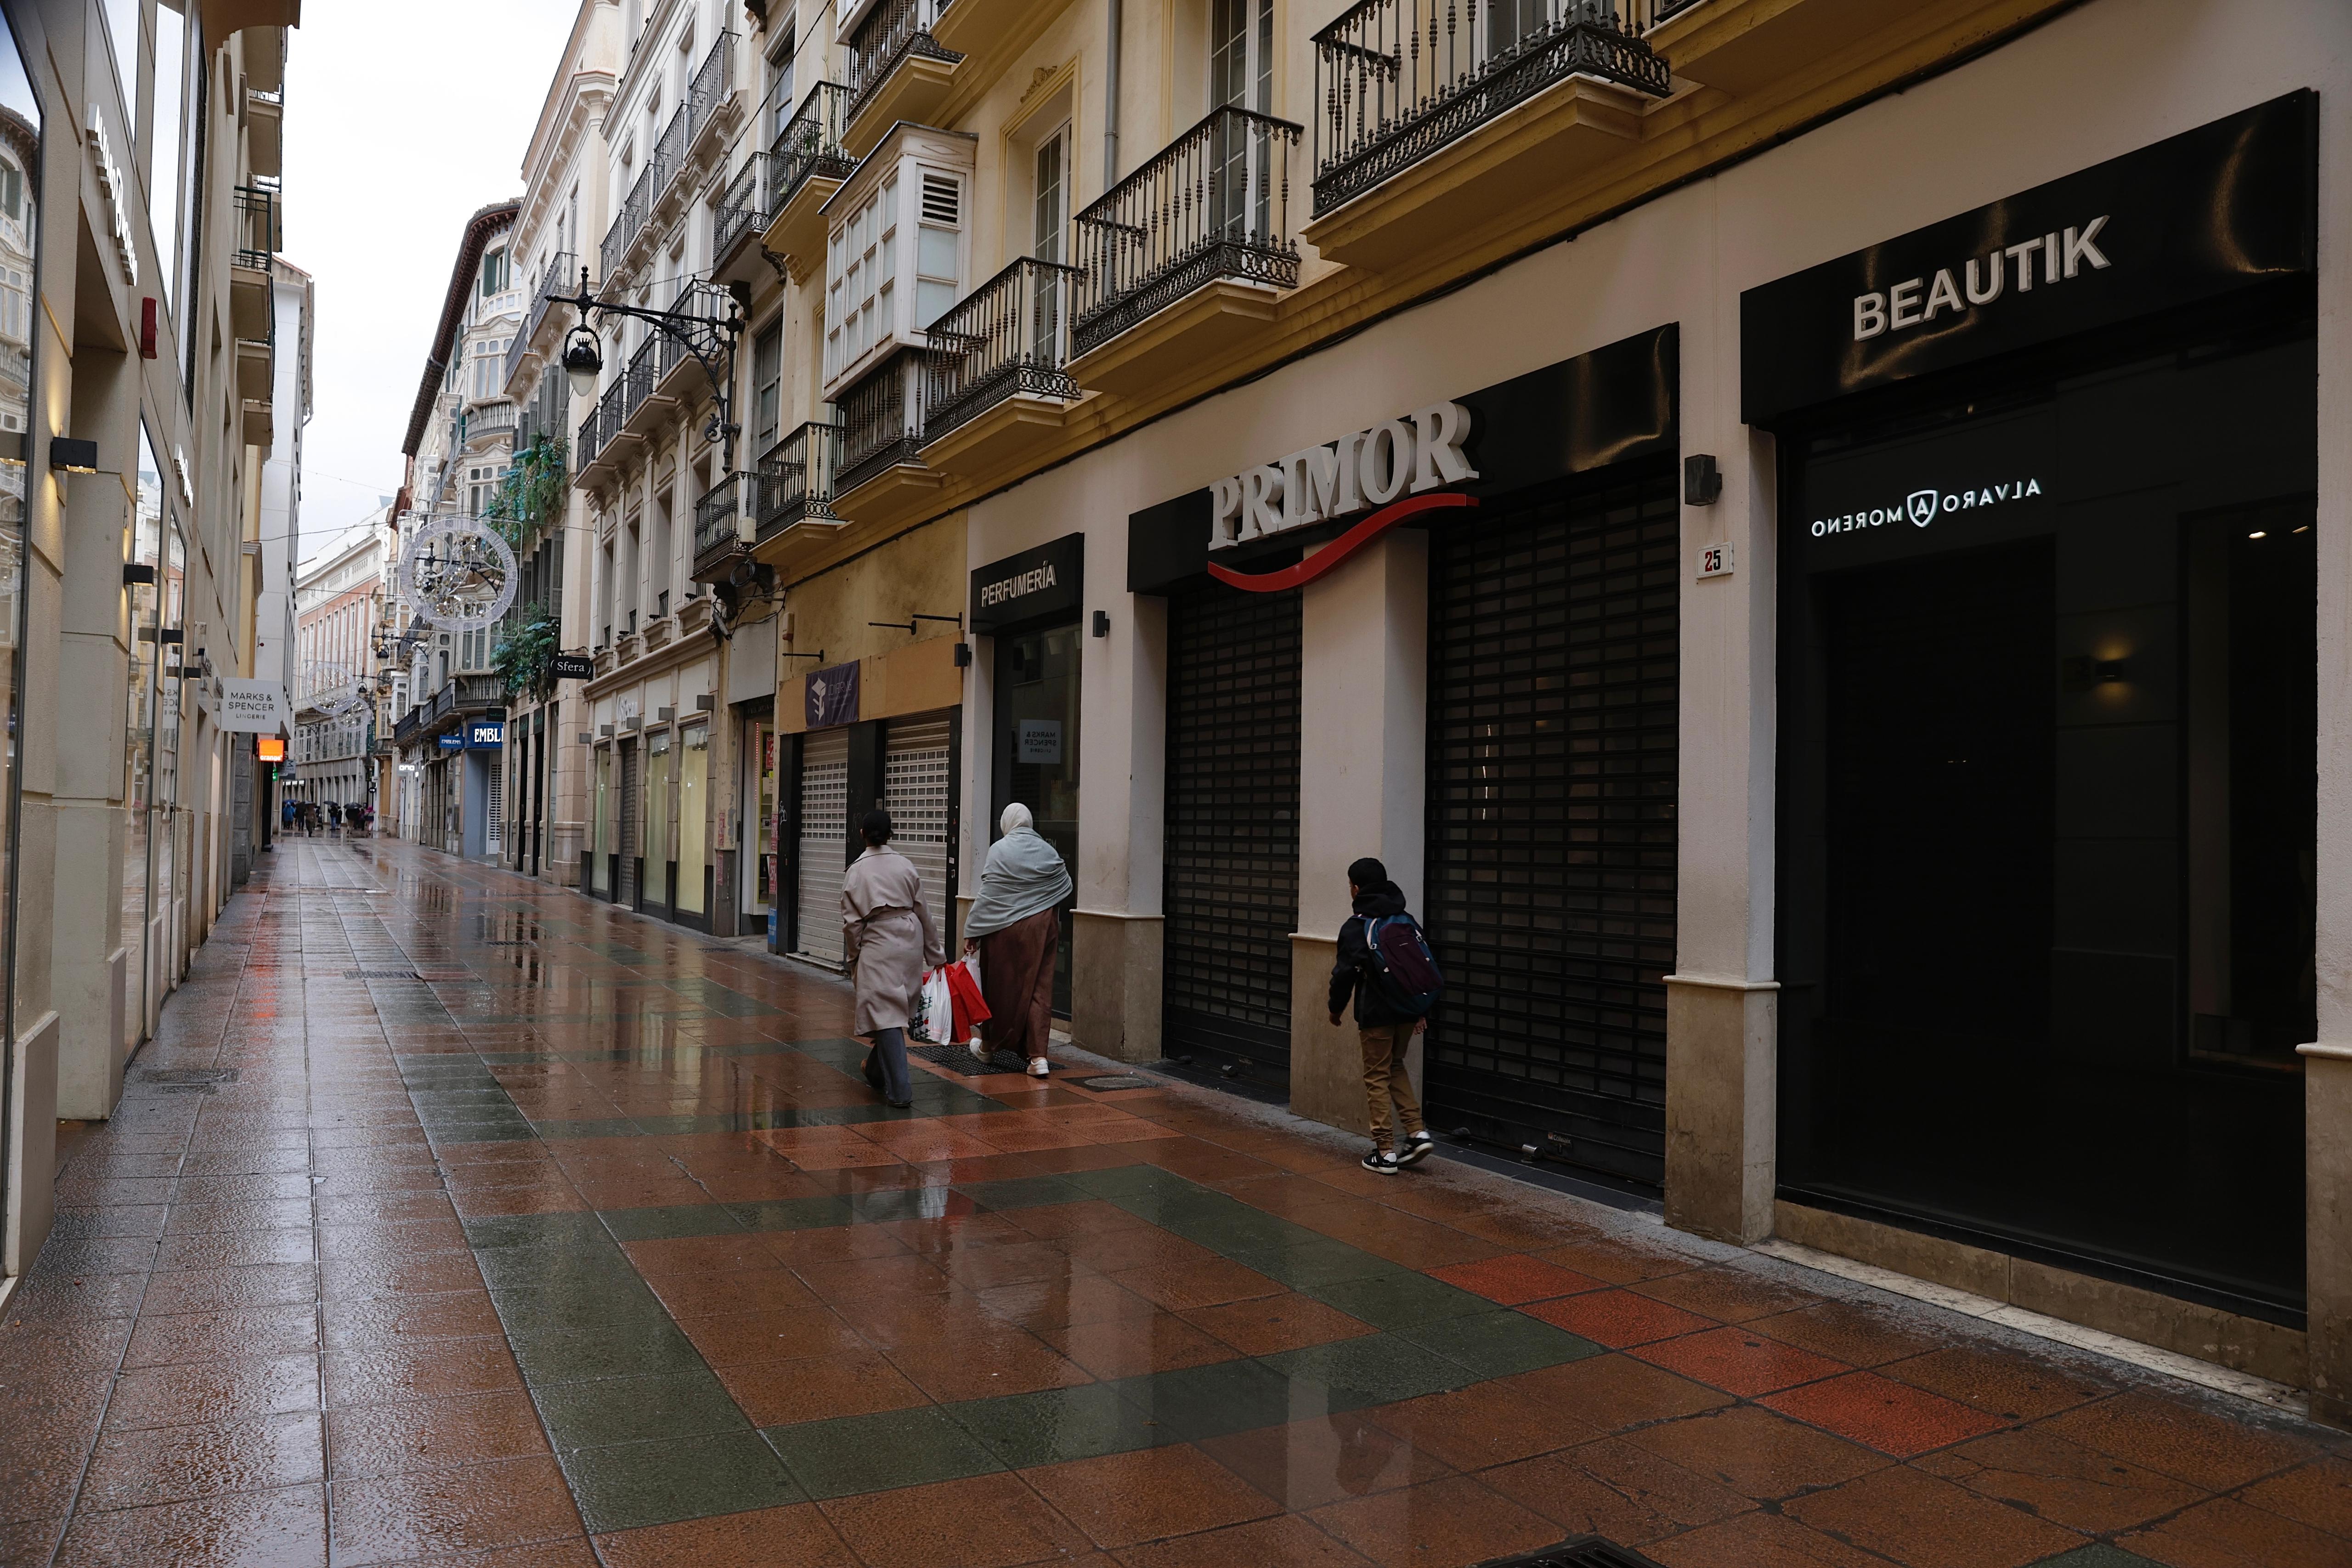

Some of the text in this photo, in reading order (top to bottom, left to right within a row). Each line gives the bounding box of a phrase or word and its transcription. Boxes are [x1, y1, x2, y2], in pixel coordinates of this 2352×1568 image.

[1854, 215, 2112, 342] BEAUTIK
[1208, 401, 1479, 551] PRIMOR
[1705, 549, 1721, 572] 25
[981, 560, 1057, 608] PERFUMERÍA
[228, 702, 274, 711] SPENCER
[231, 692, 264, 701] MARKS
